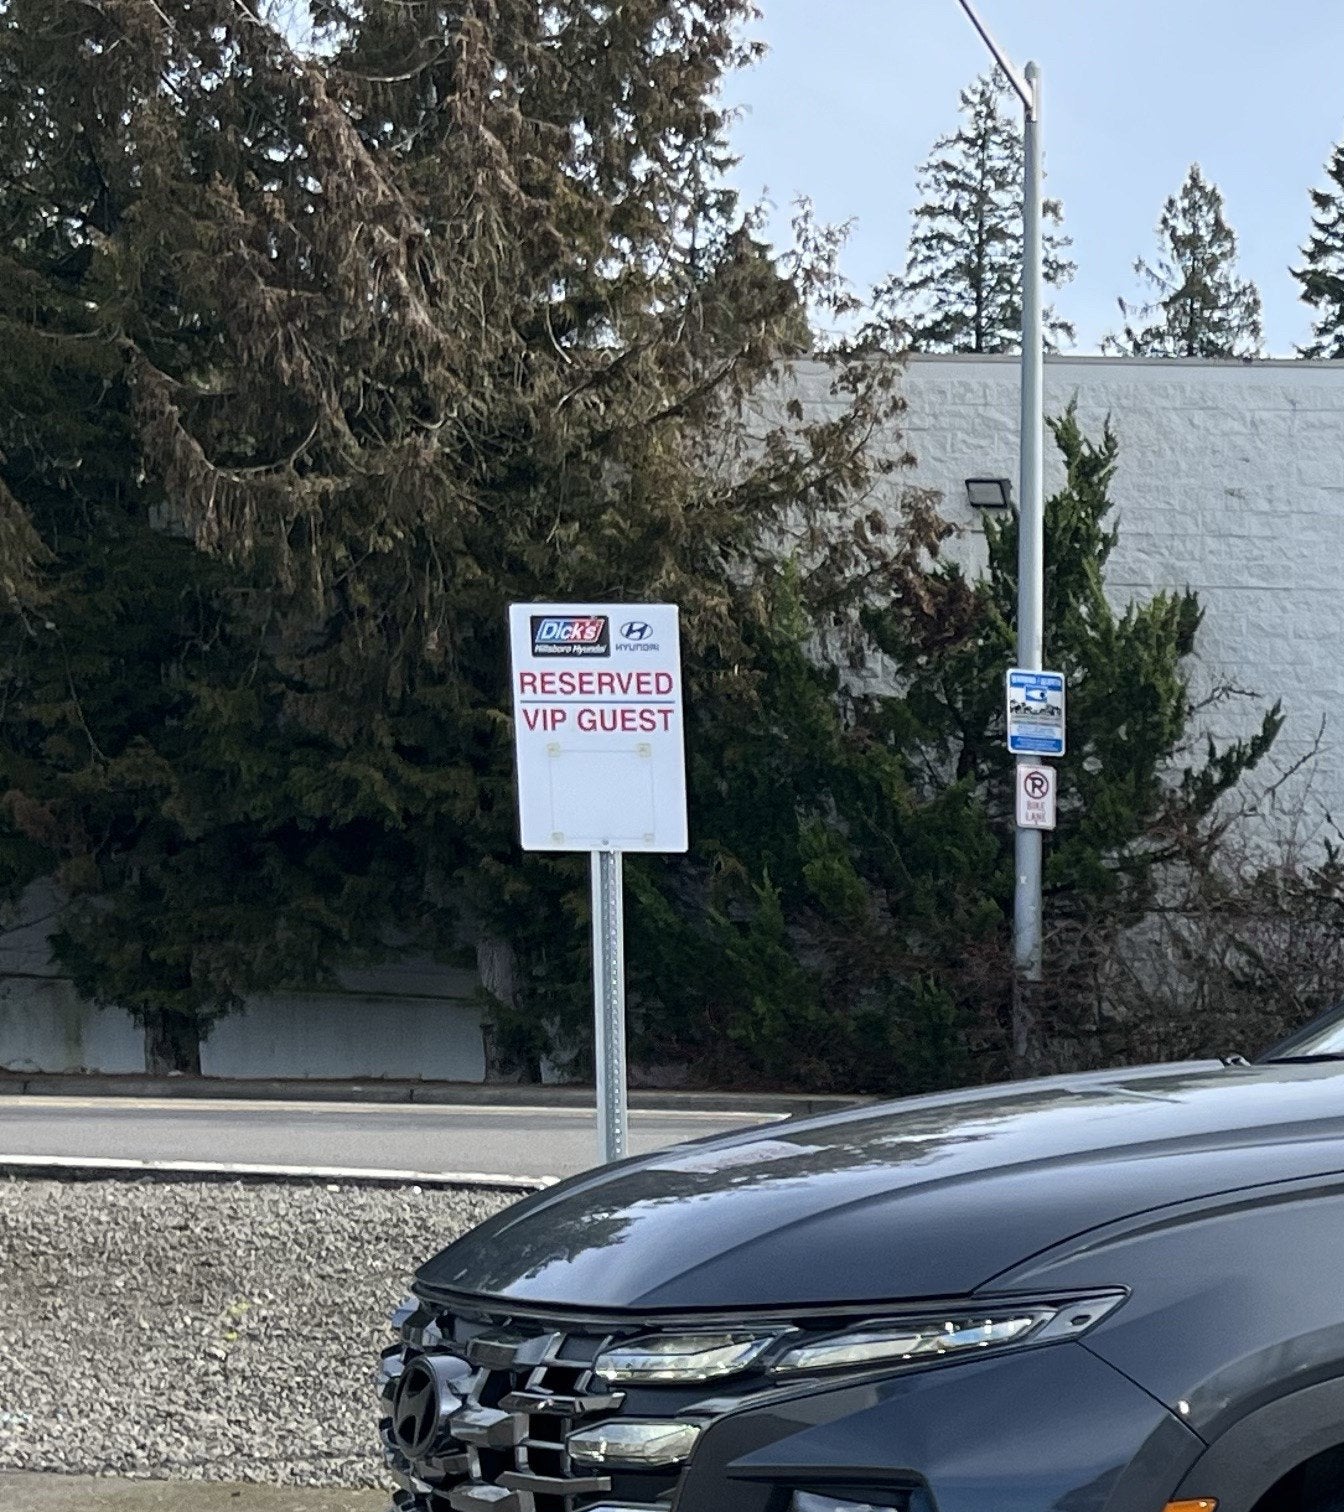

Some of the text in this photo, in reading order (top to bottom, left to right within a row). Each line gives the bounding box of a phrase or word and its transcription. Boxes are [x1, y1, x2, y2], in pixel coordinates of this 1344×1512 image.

[615, 643, 659, 652] HYUNDAI
[519, 672, 673, 695] RESERVED
[522, 708, 674, 732] VIP GUEST
